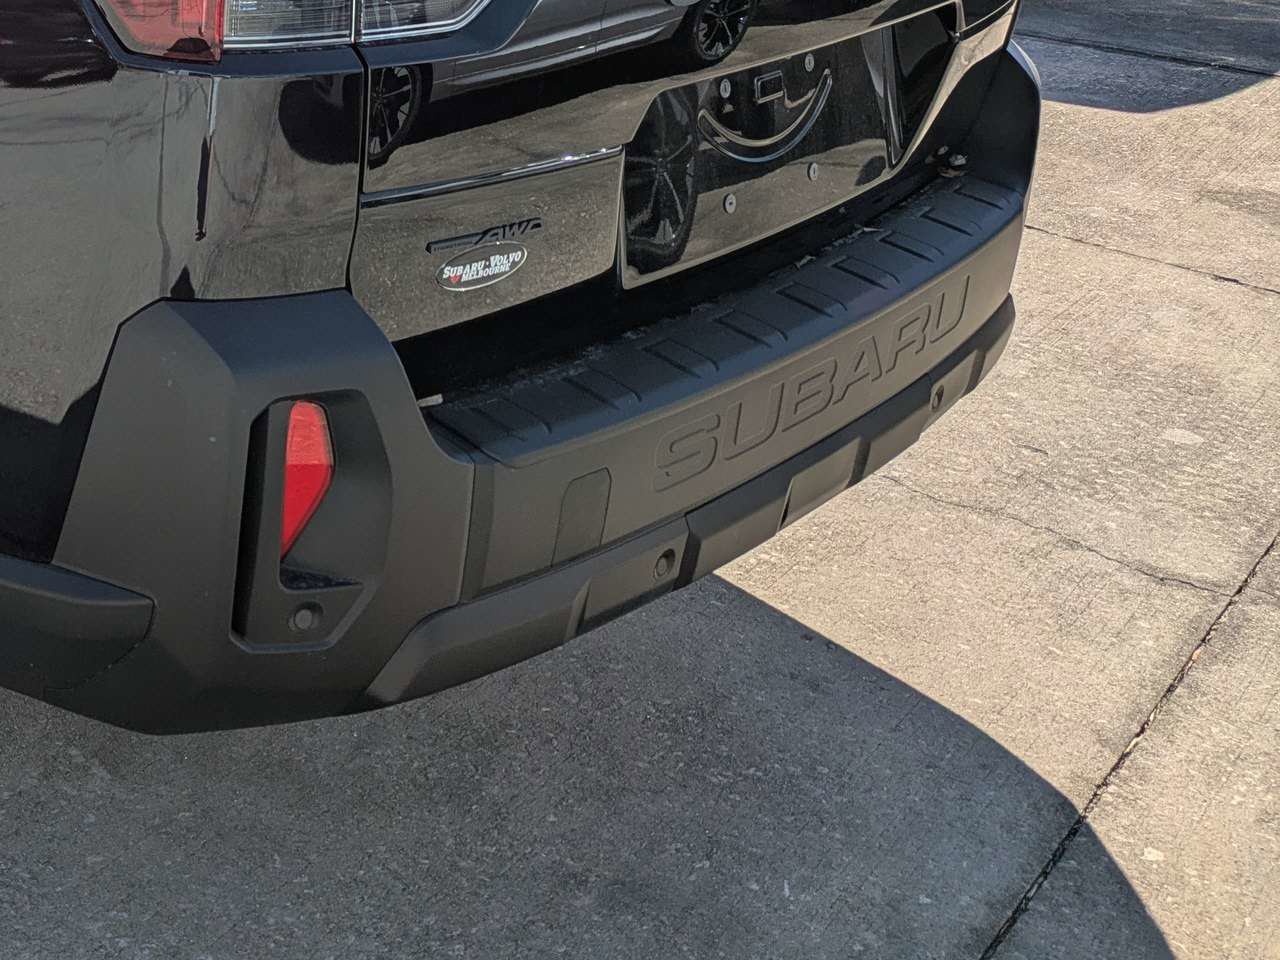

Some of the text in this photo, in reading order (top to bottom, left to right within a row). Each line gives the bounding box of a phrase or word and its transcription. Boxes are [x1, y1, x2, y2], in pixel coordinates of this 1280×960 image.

[442, 250, 522, 279] SUBARU VOLVO
[461, 262, 512, 282] MELBOURNE
[653, 274, 970, 493] SUBARU
